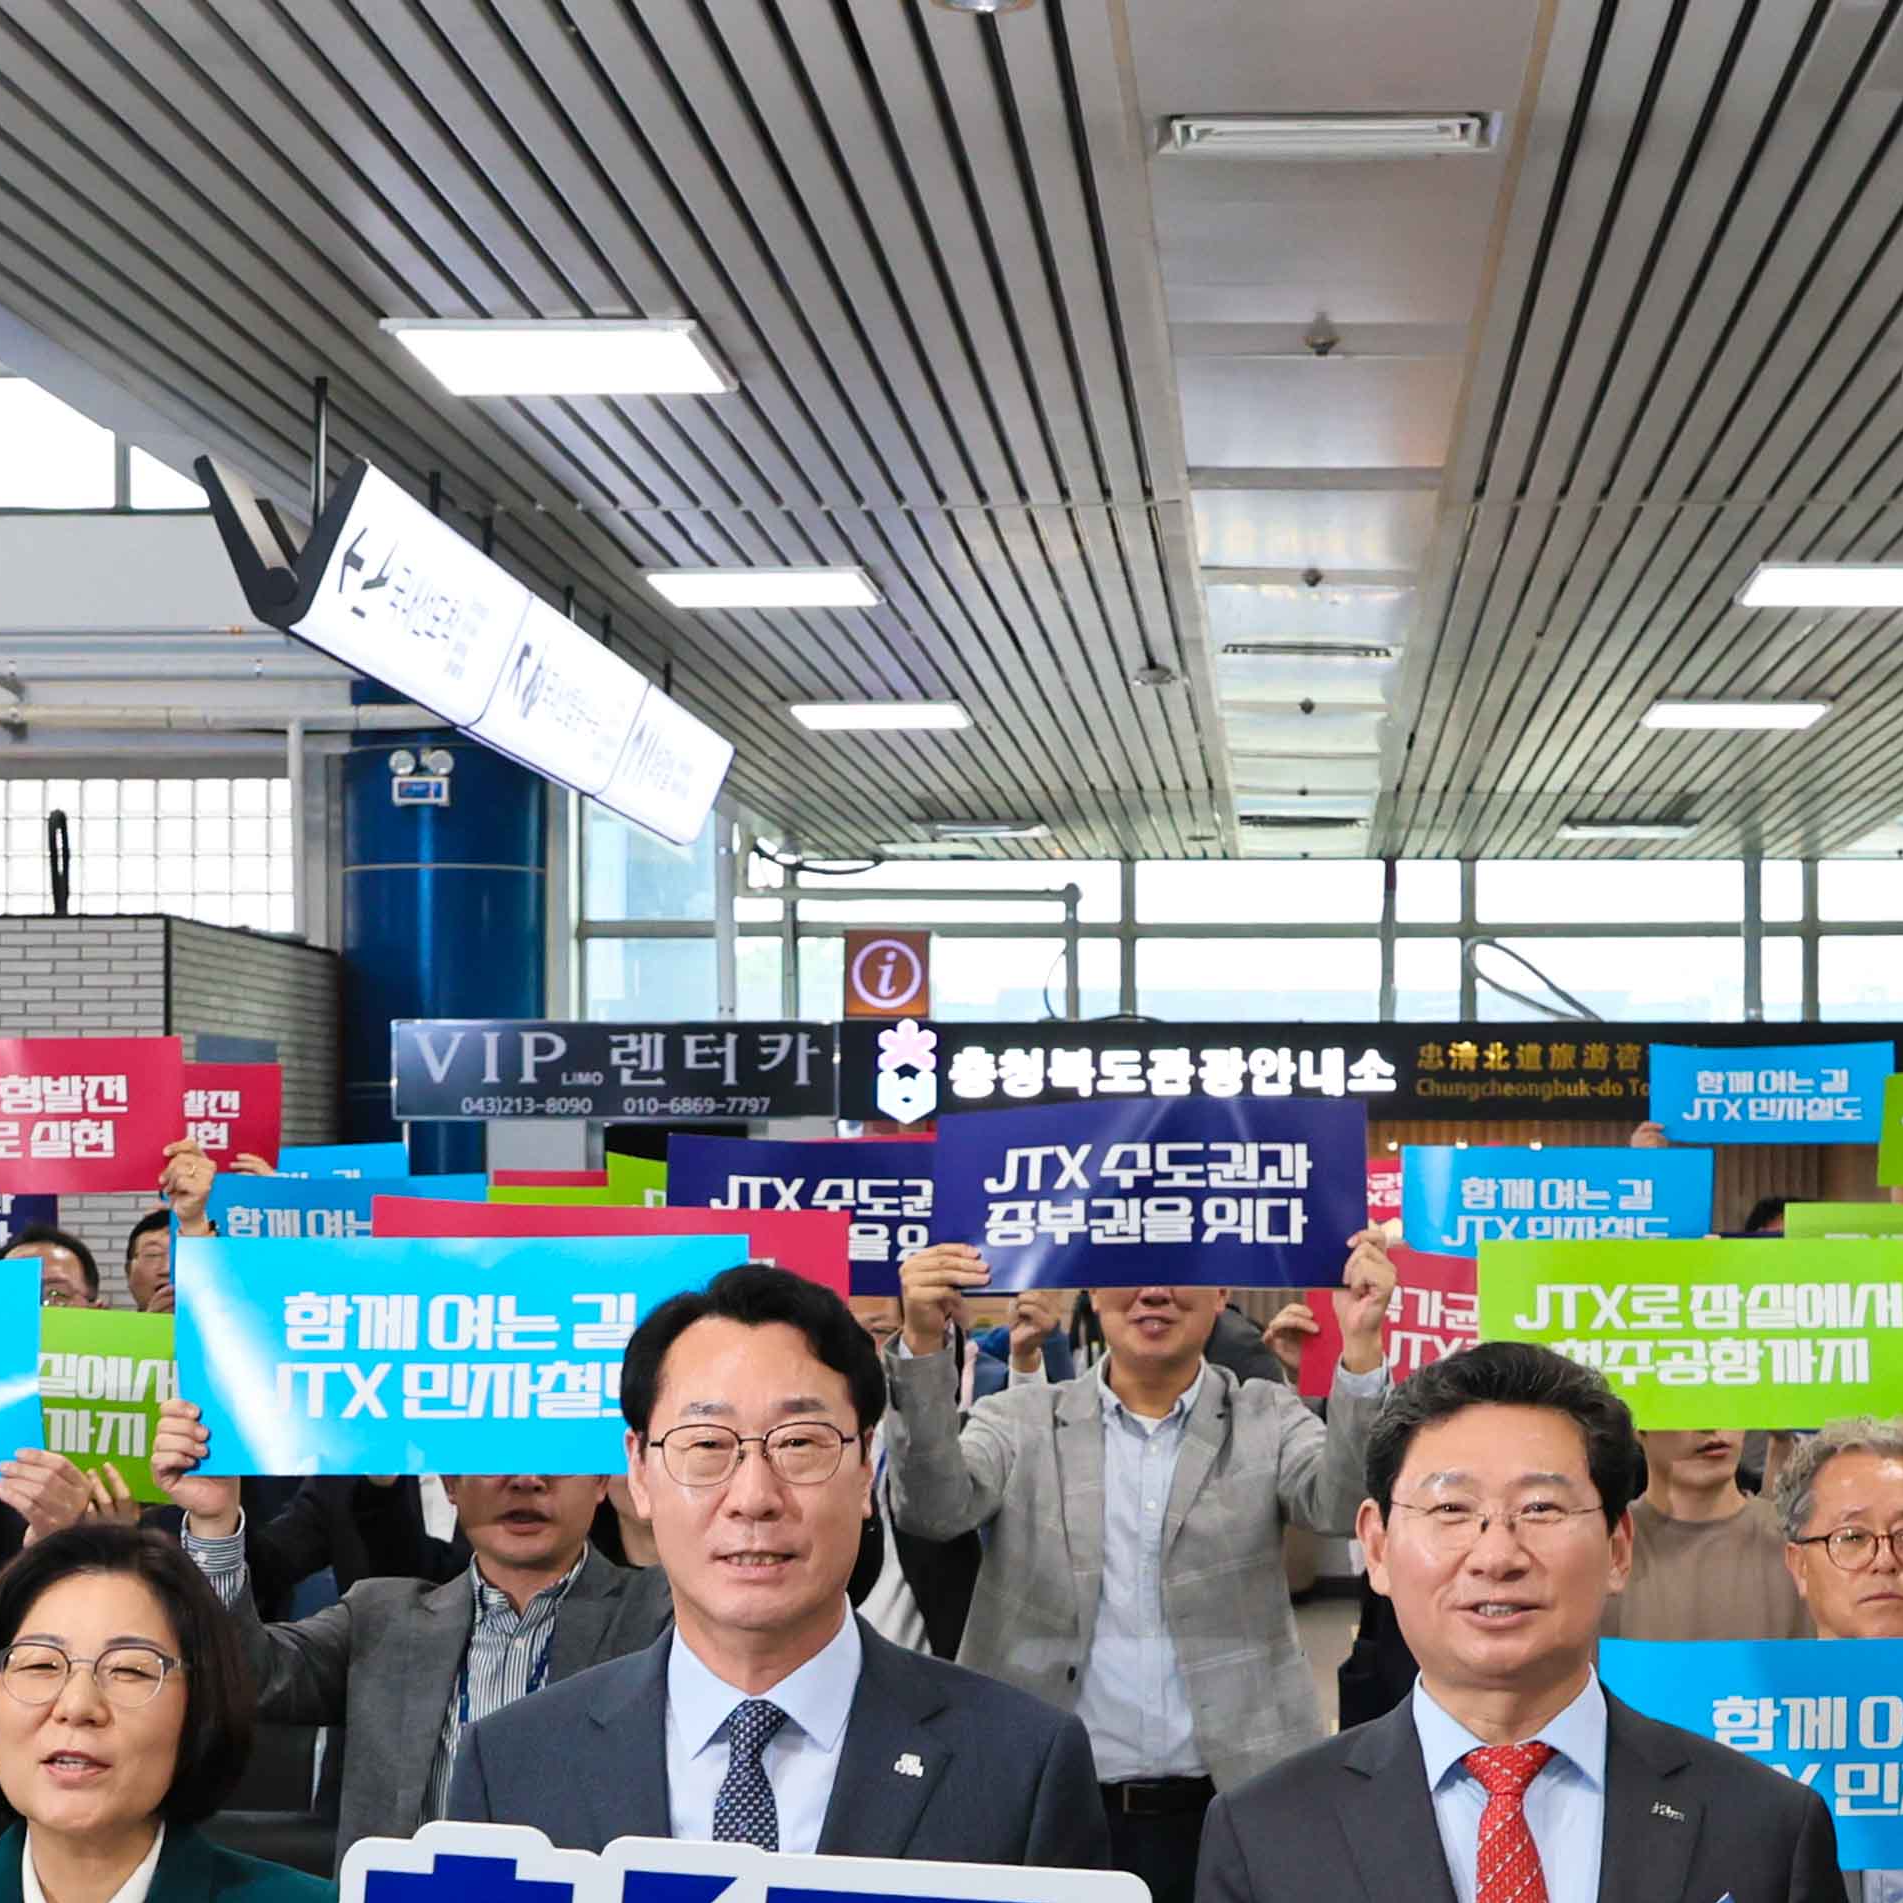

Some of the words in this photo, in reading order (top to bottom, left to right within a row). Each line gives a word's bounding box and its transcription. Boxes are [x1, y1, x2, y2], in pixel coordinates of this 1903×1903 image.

[414, 1031, 568, 1085] VIP
[608, 1032, 820, 1087] 렌터카
[949, 1045, 1397, 1099] 충청북도관광안내소
[1416, 1079, 1623, 1102] Chungcheongbuk-do
[1697, 1069, 1754, 1094] 함께
[1758, 1069, 1815, 1094] 여는
[1820, 1068, 1849, 1093] 길
[461, 1097, 593, 1115] 043)213-8090
[623, 1097, 771, 1115] 010-6869-7797
[1682, 1098, 1743, 1121] JTX
[1748, 1096, 1863, 1121] 민자철도
[30, 1119, 115, 1159] 실현
[984, 1144, 1093, 1193] JTX
[1100, 1142, 1313, 1189] 수도권과
[709, 1174, 806, 1212] JTX
[1461, 1176, 1535, 1210] 함께
[1540, 1178, 1611, 1211] 여는
[1618, 1179, 1653, 1210] 길
[985, 1197, 1195, 1247] 중부권을
[1201, 1197, 1308, 1244] 잇다
[1441, 1215, 1520, 1246] JTX
[284, 1292, 420, 1352] 함께
[428, 1294, 560, 1352] 여는
[571, 1292, 636, 1352] 길
[1514, 1283, 1683, 1332] JTX로
[1712, 1695, 1847, 1753] 함께
